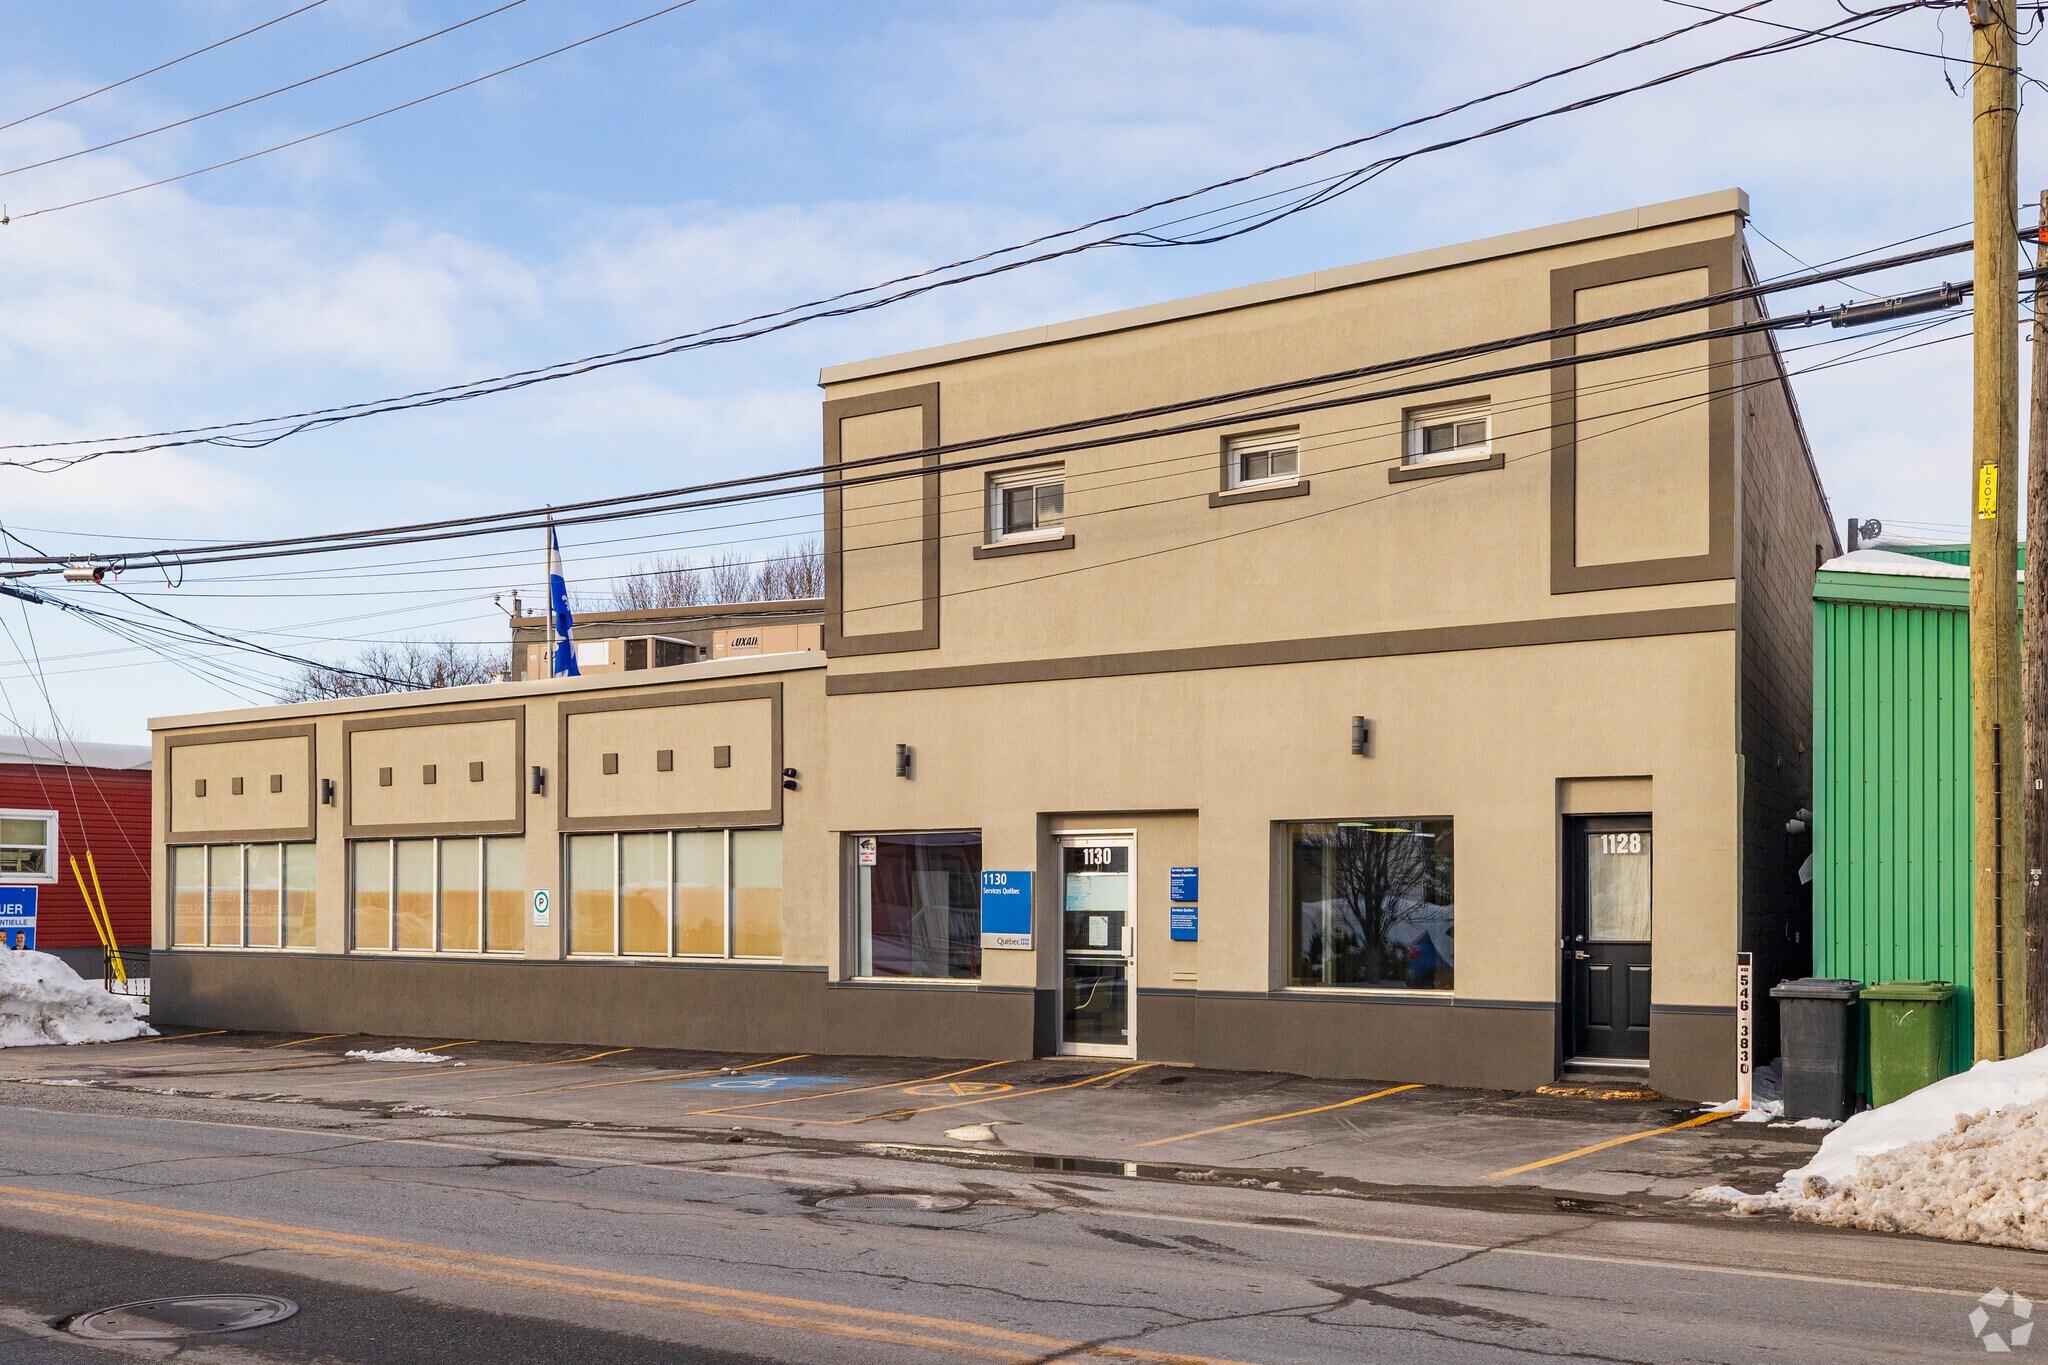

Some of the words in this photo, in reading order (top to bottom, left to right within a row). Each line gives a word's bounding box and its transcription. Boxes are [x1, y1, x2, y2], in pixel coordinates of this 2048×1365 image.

[1600, 832, 1641, 854] 1128
[1083, 847, 1112, 865] 1130
[983, 873, 1007, 885] 1130
[983, 887, 1001, 895] Services
[1002, 887, 1020, 895] Québec
[538, 897, 545, 907] P
[996, 937, 1020, 946] Québec
